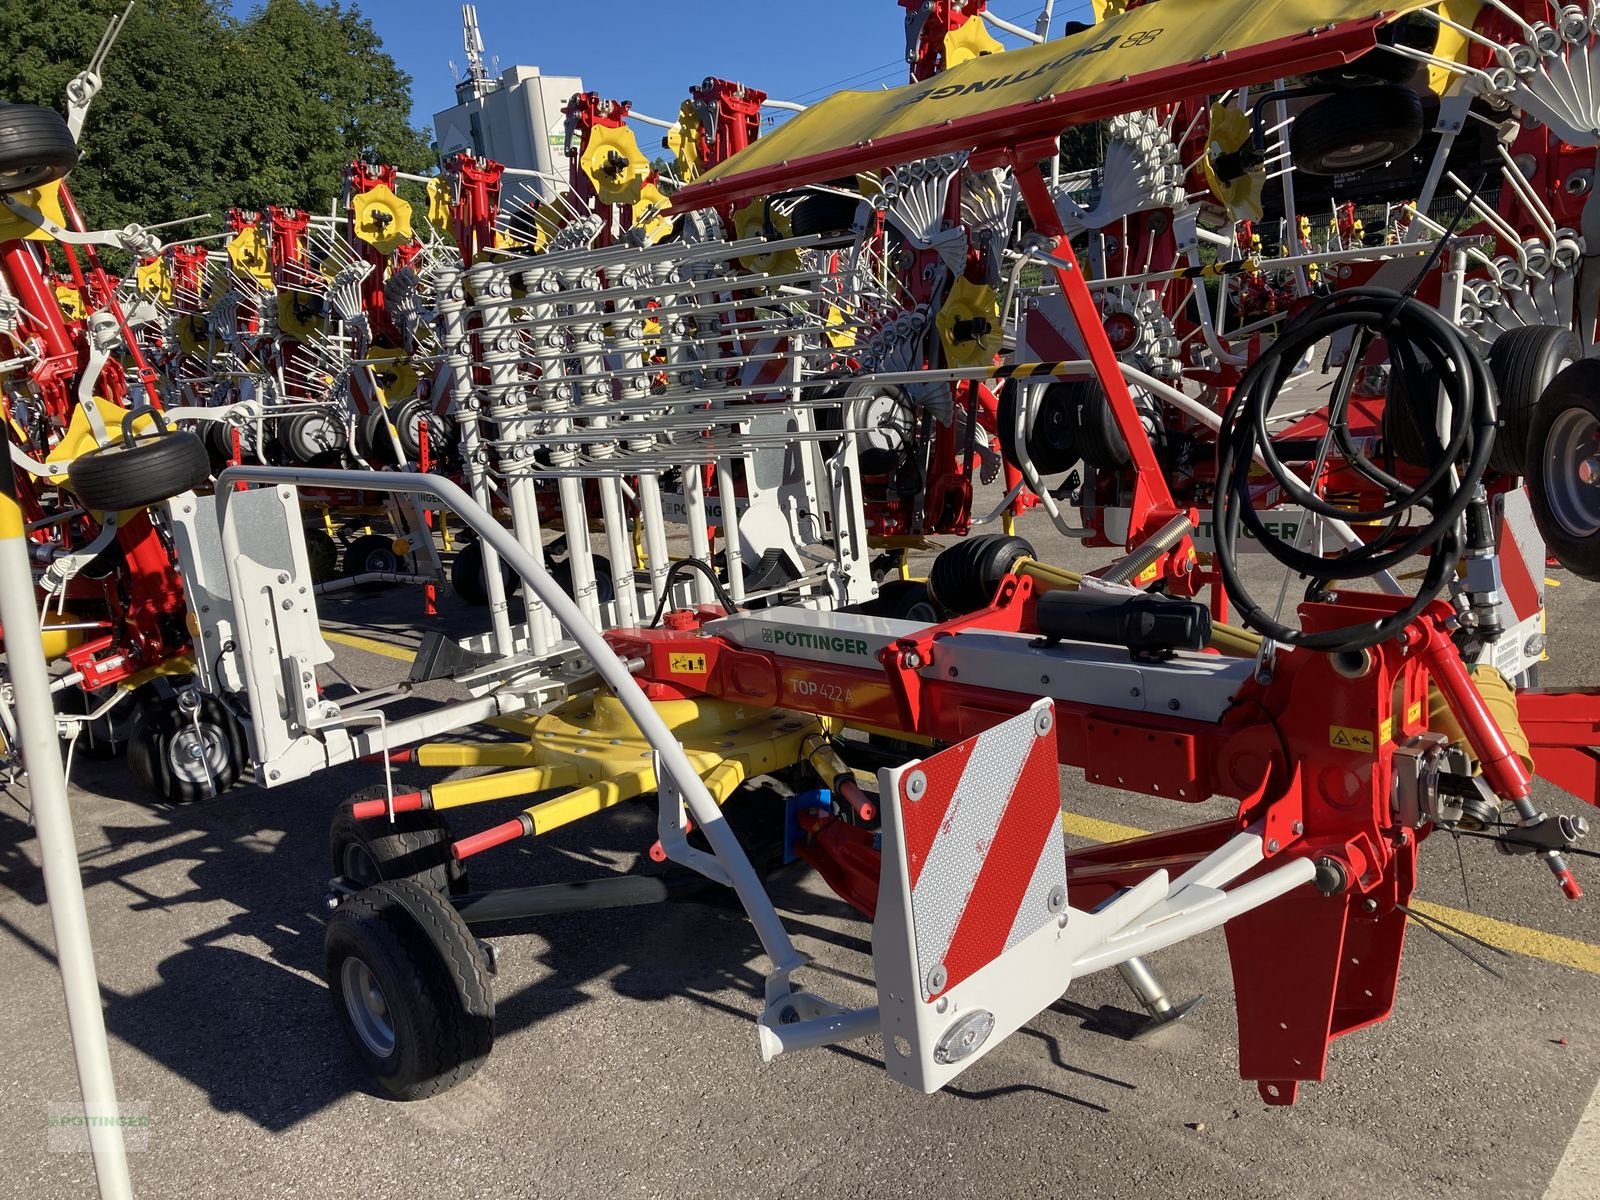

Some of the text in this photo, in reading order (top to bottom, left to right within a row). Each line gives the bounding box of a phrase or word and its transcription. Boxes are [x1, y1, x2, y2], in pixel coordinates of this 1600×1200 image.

[790, 678, 854, 702] TOP 422 A
